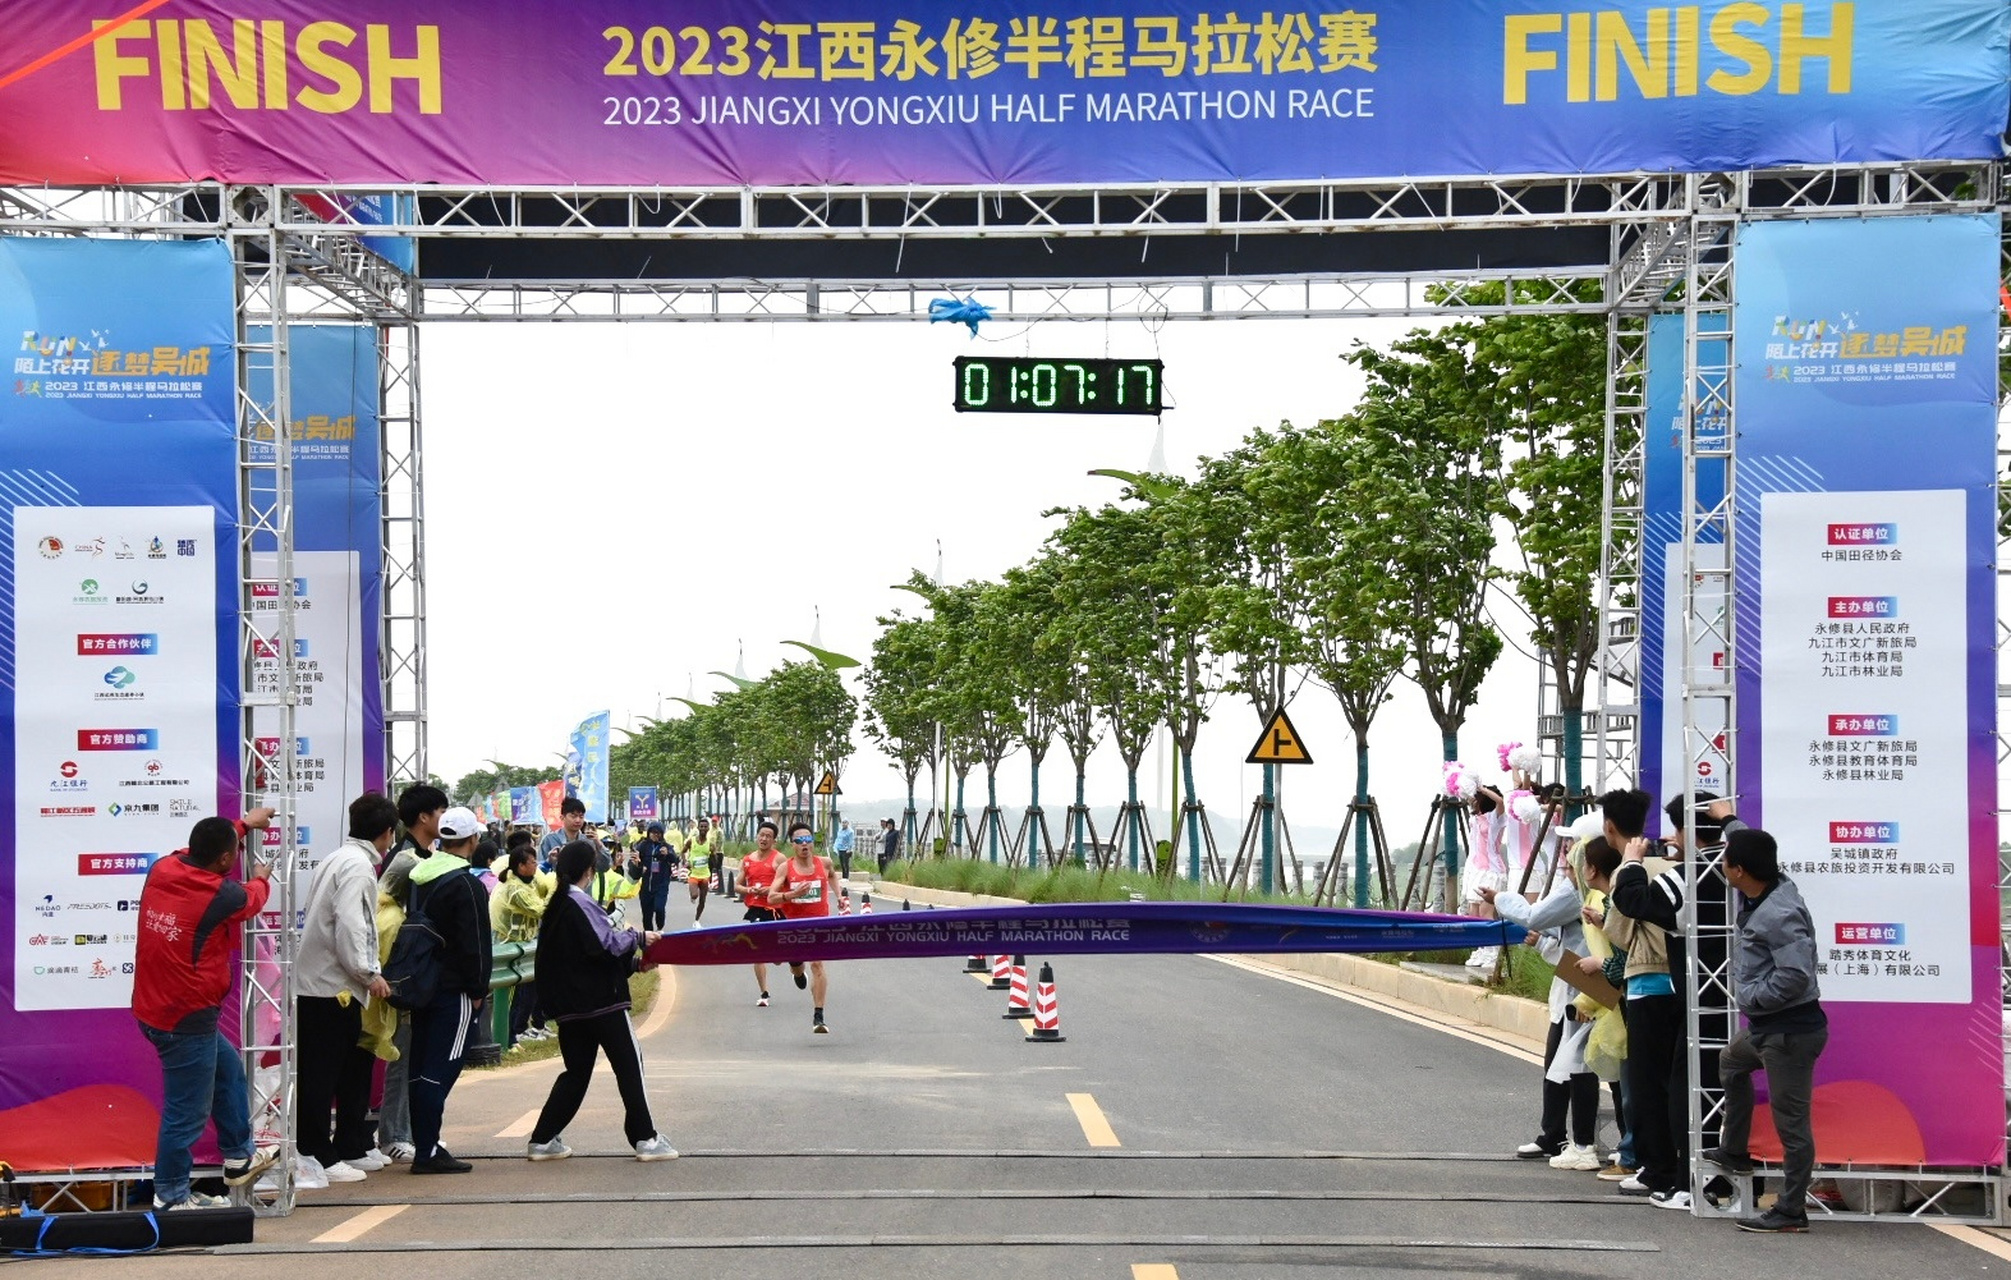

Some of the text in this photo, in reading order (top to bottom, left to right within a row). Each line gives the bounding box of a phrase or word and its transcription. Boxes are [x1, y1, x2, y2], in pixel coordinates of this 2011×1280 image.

[602, 10, 1378, 82] 2023江西永修半程马拉松赛
[1503, 2, 1854, 105] FINISH
[92, 19, 442, 115] FINISH
[603, 88, 1374, 125] 2023 JIANGXI YONGXIU HALF MARATHON RACE
[1771, 315, 1827, 341] RUN
[20, 331, 76, 356] RUN
[1839, 325, 1968, 359] 逐梦吴城
[91, 347, 210, 376] 逐梦吴城
[1793, 366, 1825, 376] 2023
[45, 382, 78, 391] 2023
[965, 364, 1153, 406] 01:07:17
[1835, 528, 1888, 540] 认证单位
[1821, 549, 1902, 561] 中国田径协会
[1835, 601, 1888, 613] 主办单位
[1815, 623, 1910, 635] 永修县人民政府
[83, 638, 152, 649] 官方合作伙伴
[1808, 637, 1917, 649] 九江市文广新旅局
[1822, 651, 1903, 663] 九江市体育局
[1822, 665, 1903, 677] 九江市林业局
[1835, 719, 1890, 731] 承办单位
[90, 734, 148, 745] 官方赞助商
[1808, 740, 1917, 752] 永修县文广新旅局
[1808, 755, 1917, 766] 永修县教育体育局
[1823, 769, 1903, 781] 永修县林业局
[124, 804, 159, 812] 京九集团
[1836, 826, 1890, 838] 协办单位
[1830, 848, 1898, 860] 吴城镇政府
[91, 858, 147, 869] 官方支持商
[1778, 862, 1955, 874] 永修县农旅投资开发有限公司
[777, 930, 1130, 944] 2023 JIANGXI YONGXIU HALF MARATHON RACE
[1842, 928, 1896, 940] 运营单位
[1829, 950, 1912, 961] 踏秀体育文化
